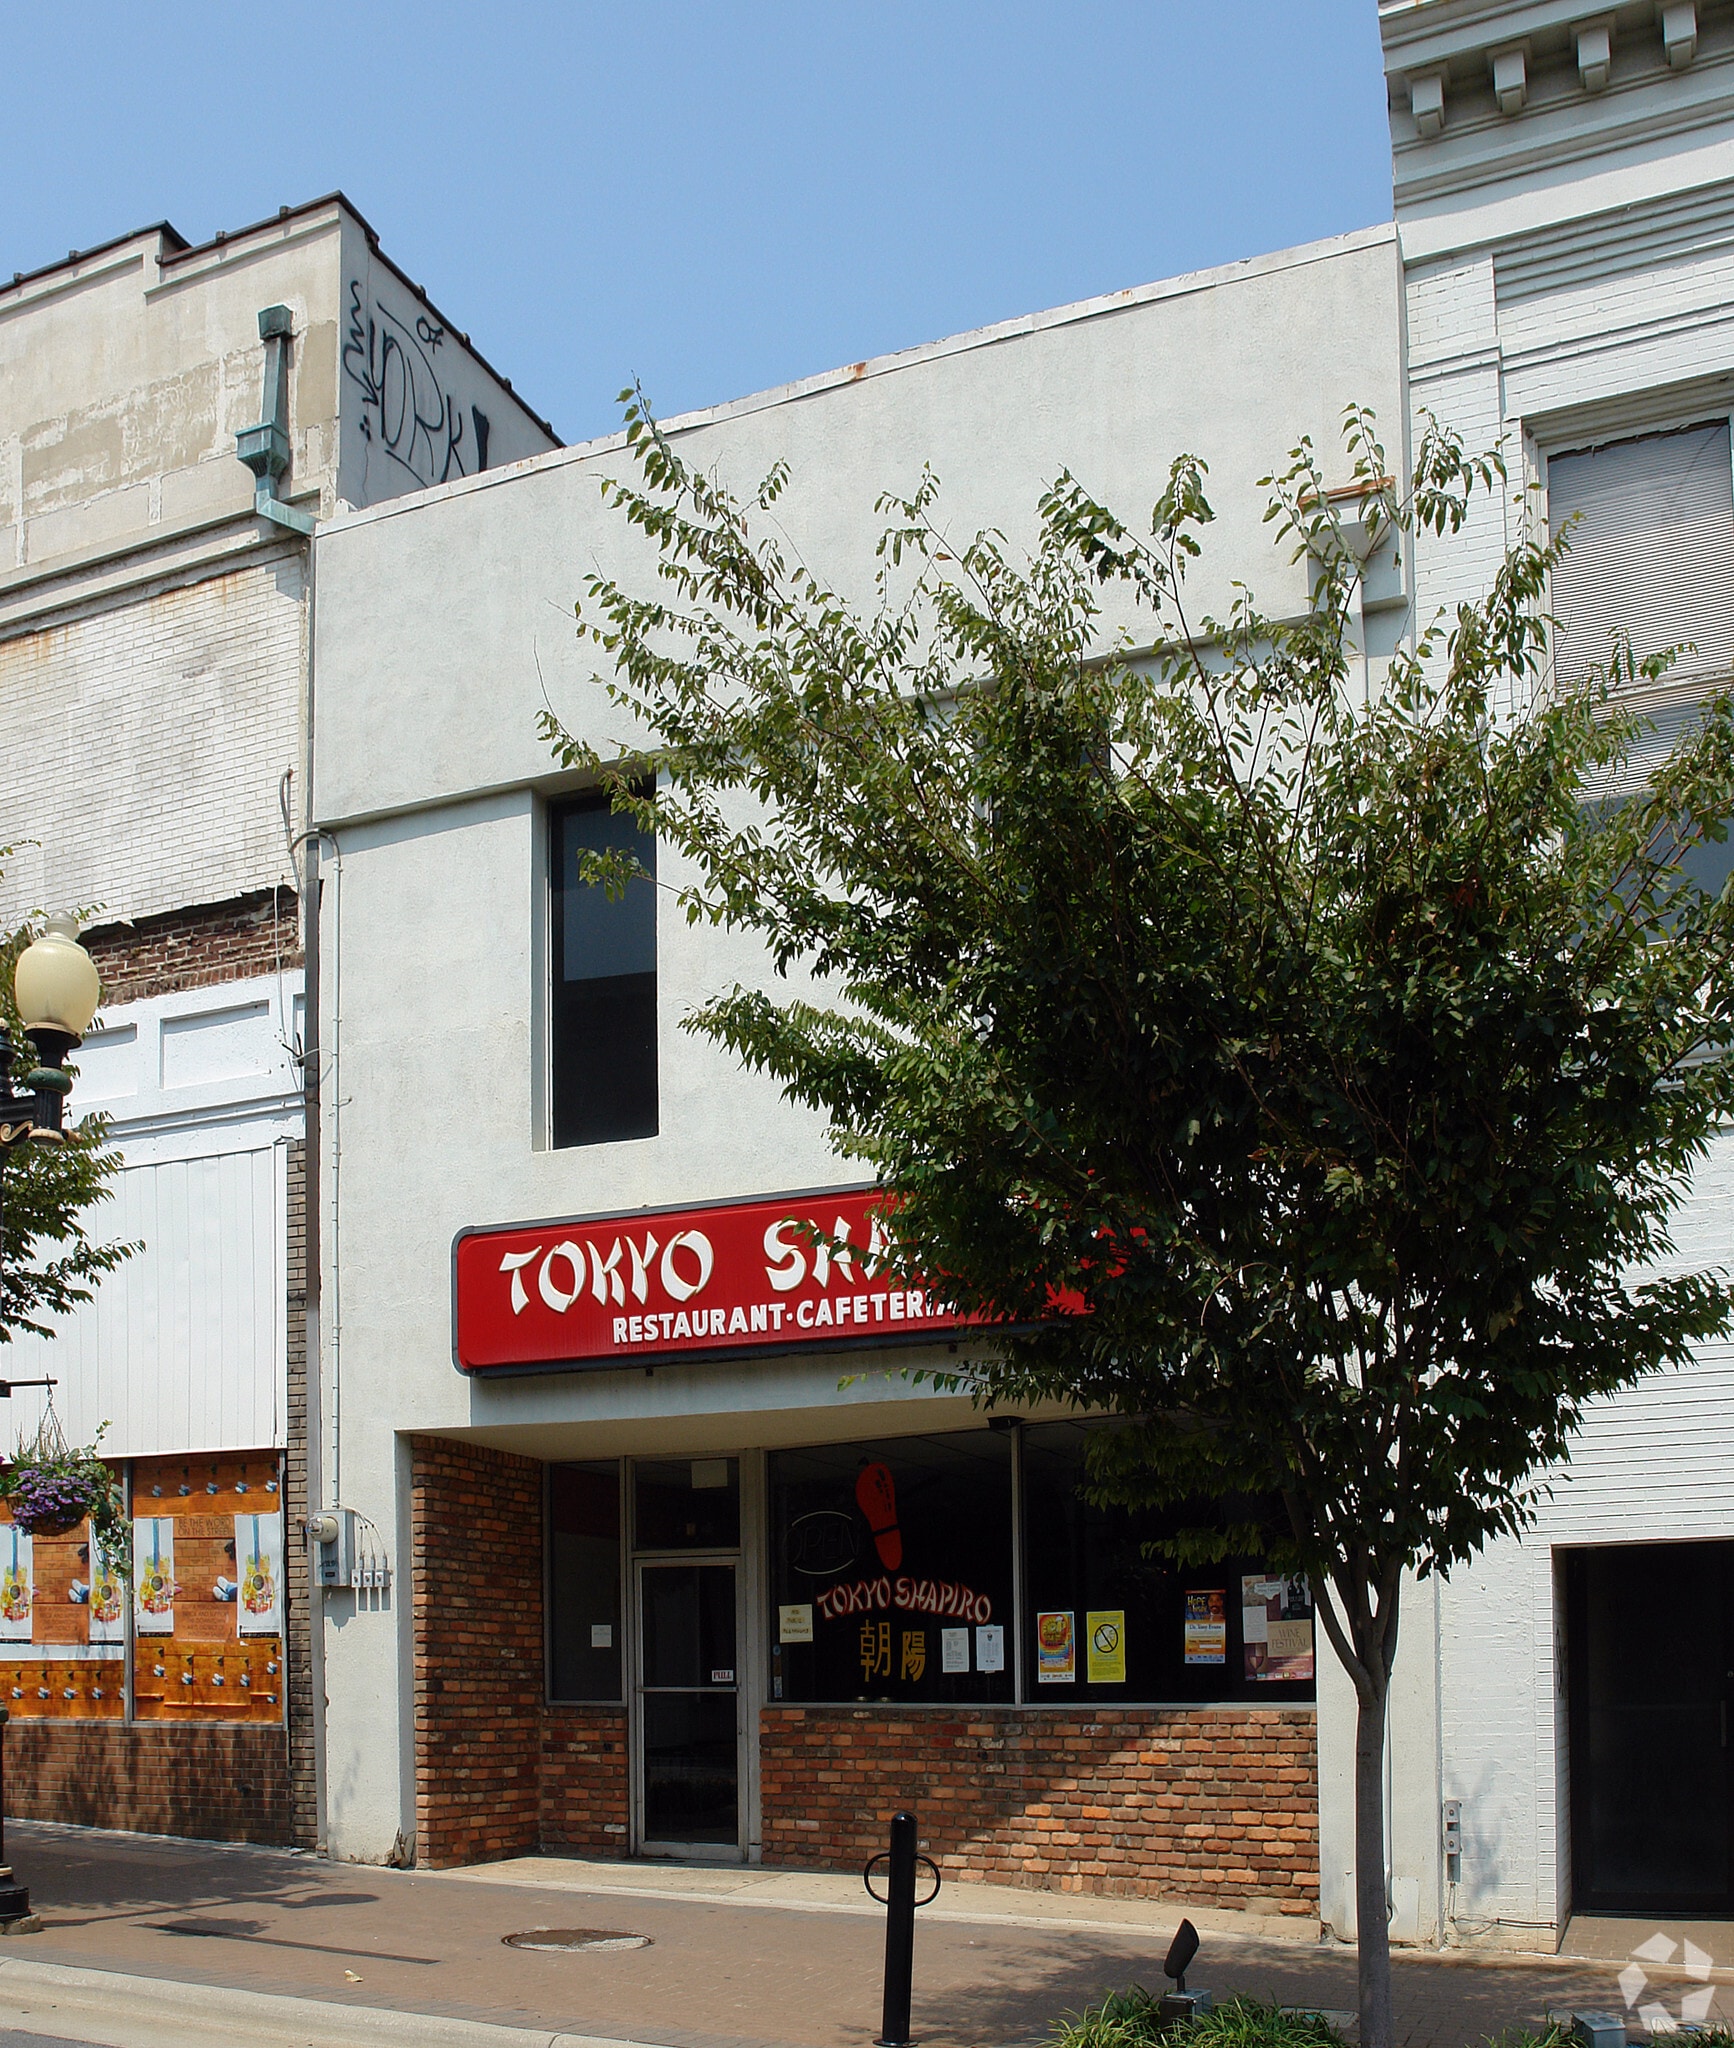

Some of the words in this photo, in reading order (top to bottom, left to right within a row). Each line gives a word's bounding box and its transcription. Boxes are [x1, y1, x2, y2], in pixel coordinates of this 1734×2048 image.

[499, 1229, 715, 1316] TOKYO
[765, 1214, 912, 1291] SHA
[613, 1302, 786, 1344] RESTAURANT
[815, 1576, 891, 1620] TOKYO
[893, 1576, 992, 1625] SHAPIRO
[860, 1619, 926, 1682] 朝陽
